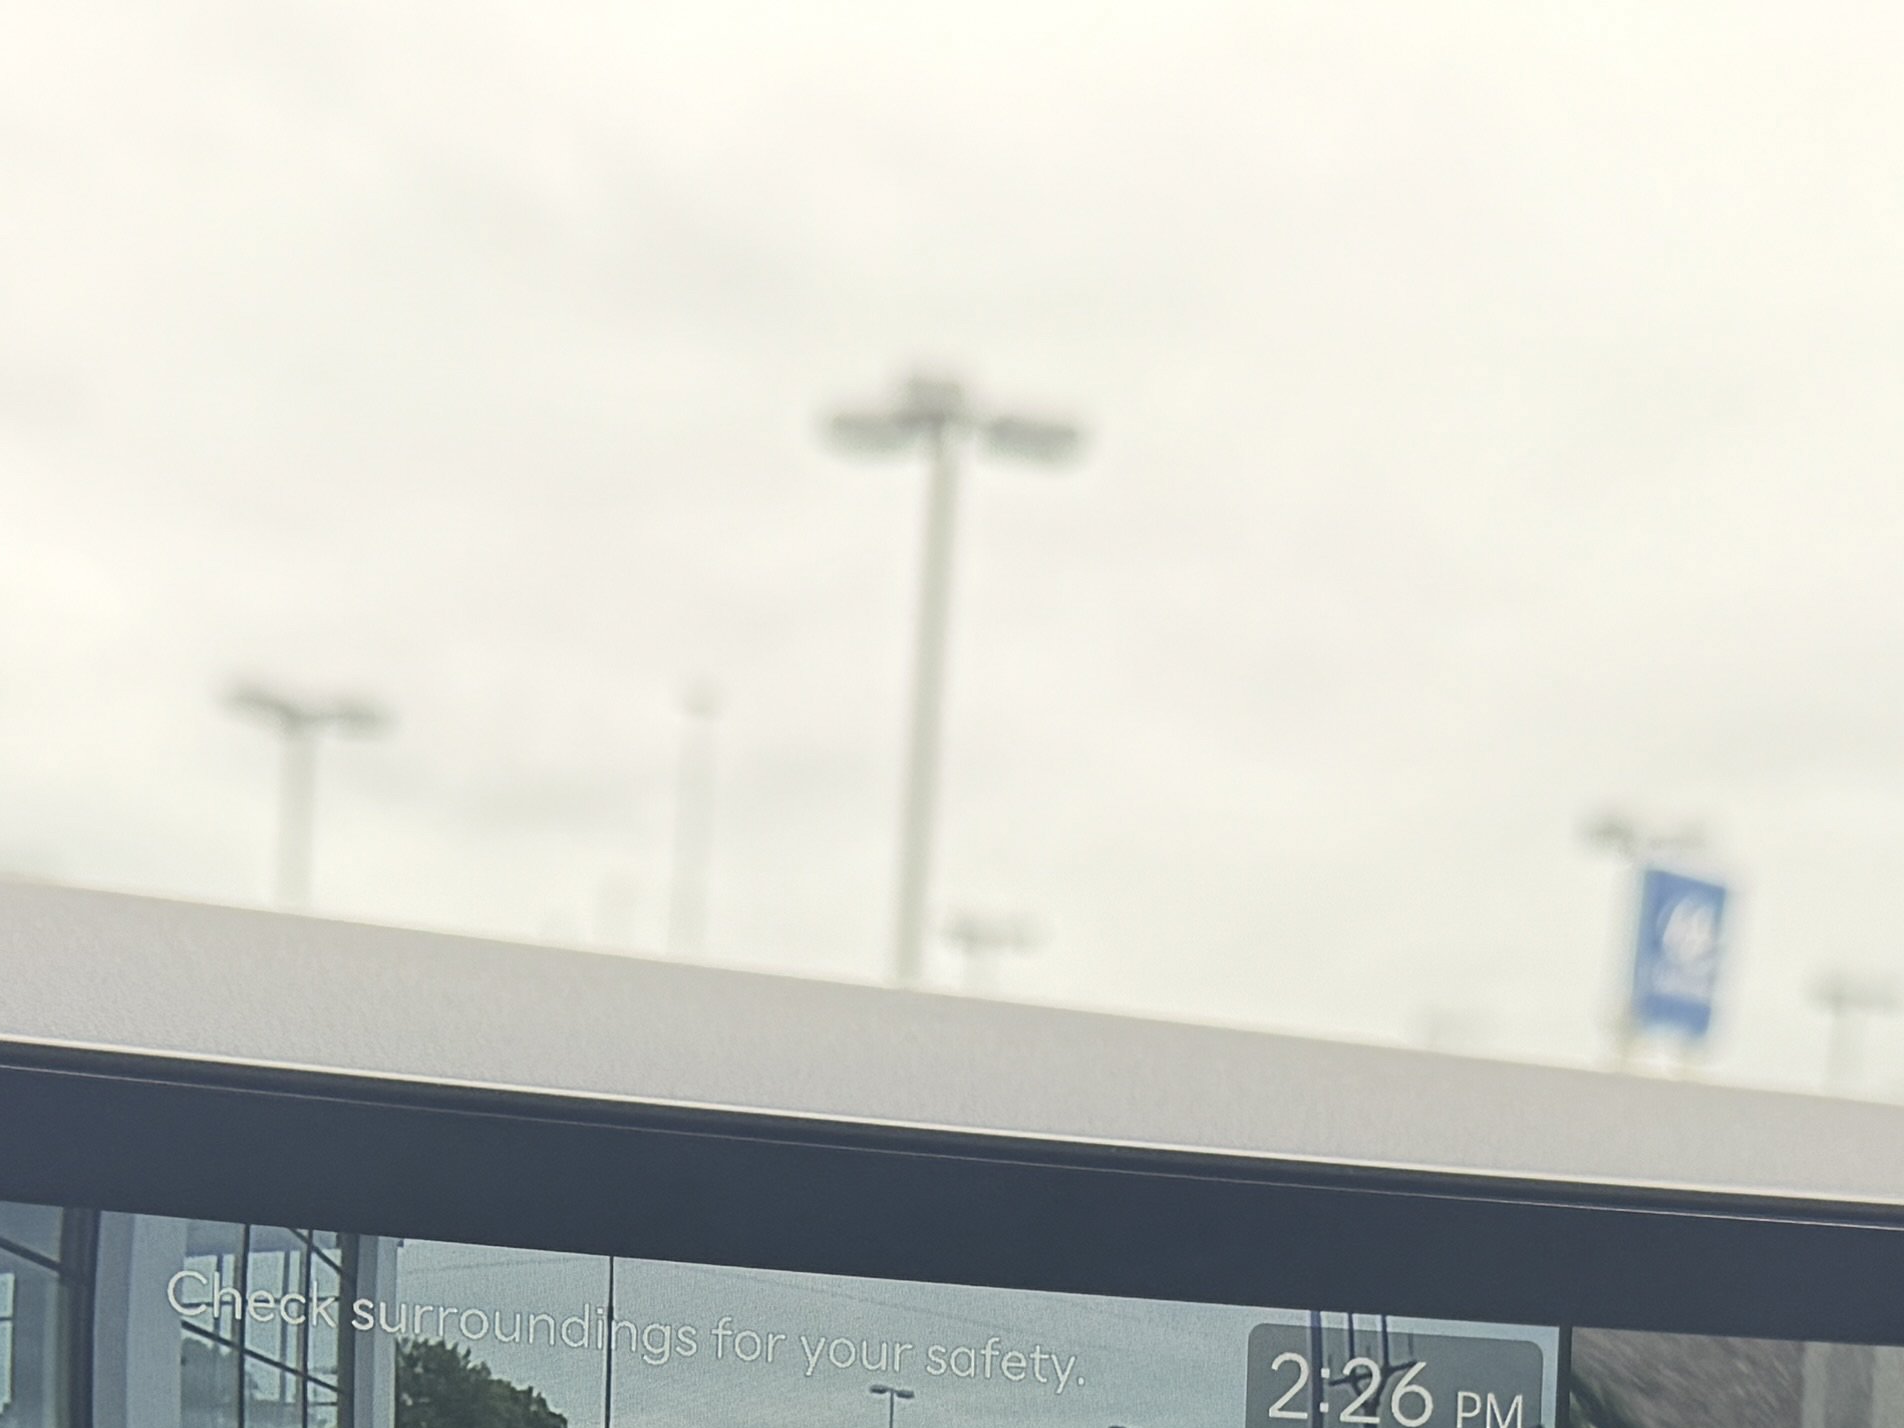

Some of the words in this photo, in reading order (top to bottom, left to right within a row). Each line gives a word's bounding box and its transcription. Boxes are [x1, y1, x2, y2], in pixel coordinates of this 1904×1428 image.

[167, 1269, 338, 1328] Check
[351, 1297, 698, 1366] surroundings
[711, 1316, 787, 1364] for
[800, 1333, 914, 1377] your
[925, 1336, 1085, 1395] safety.
[1268, 1351, 1434, 1428] 2:26
